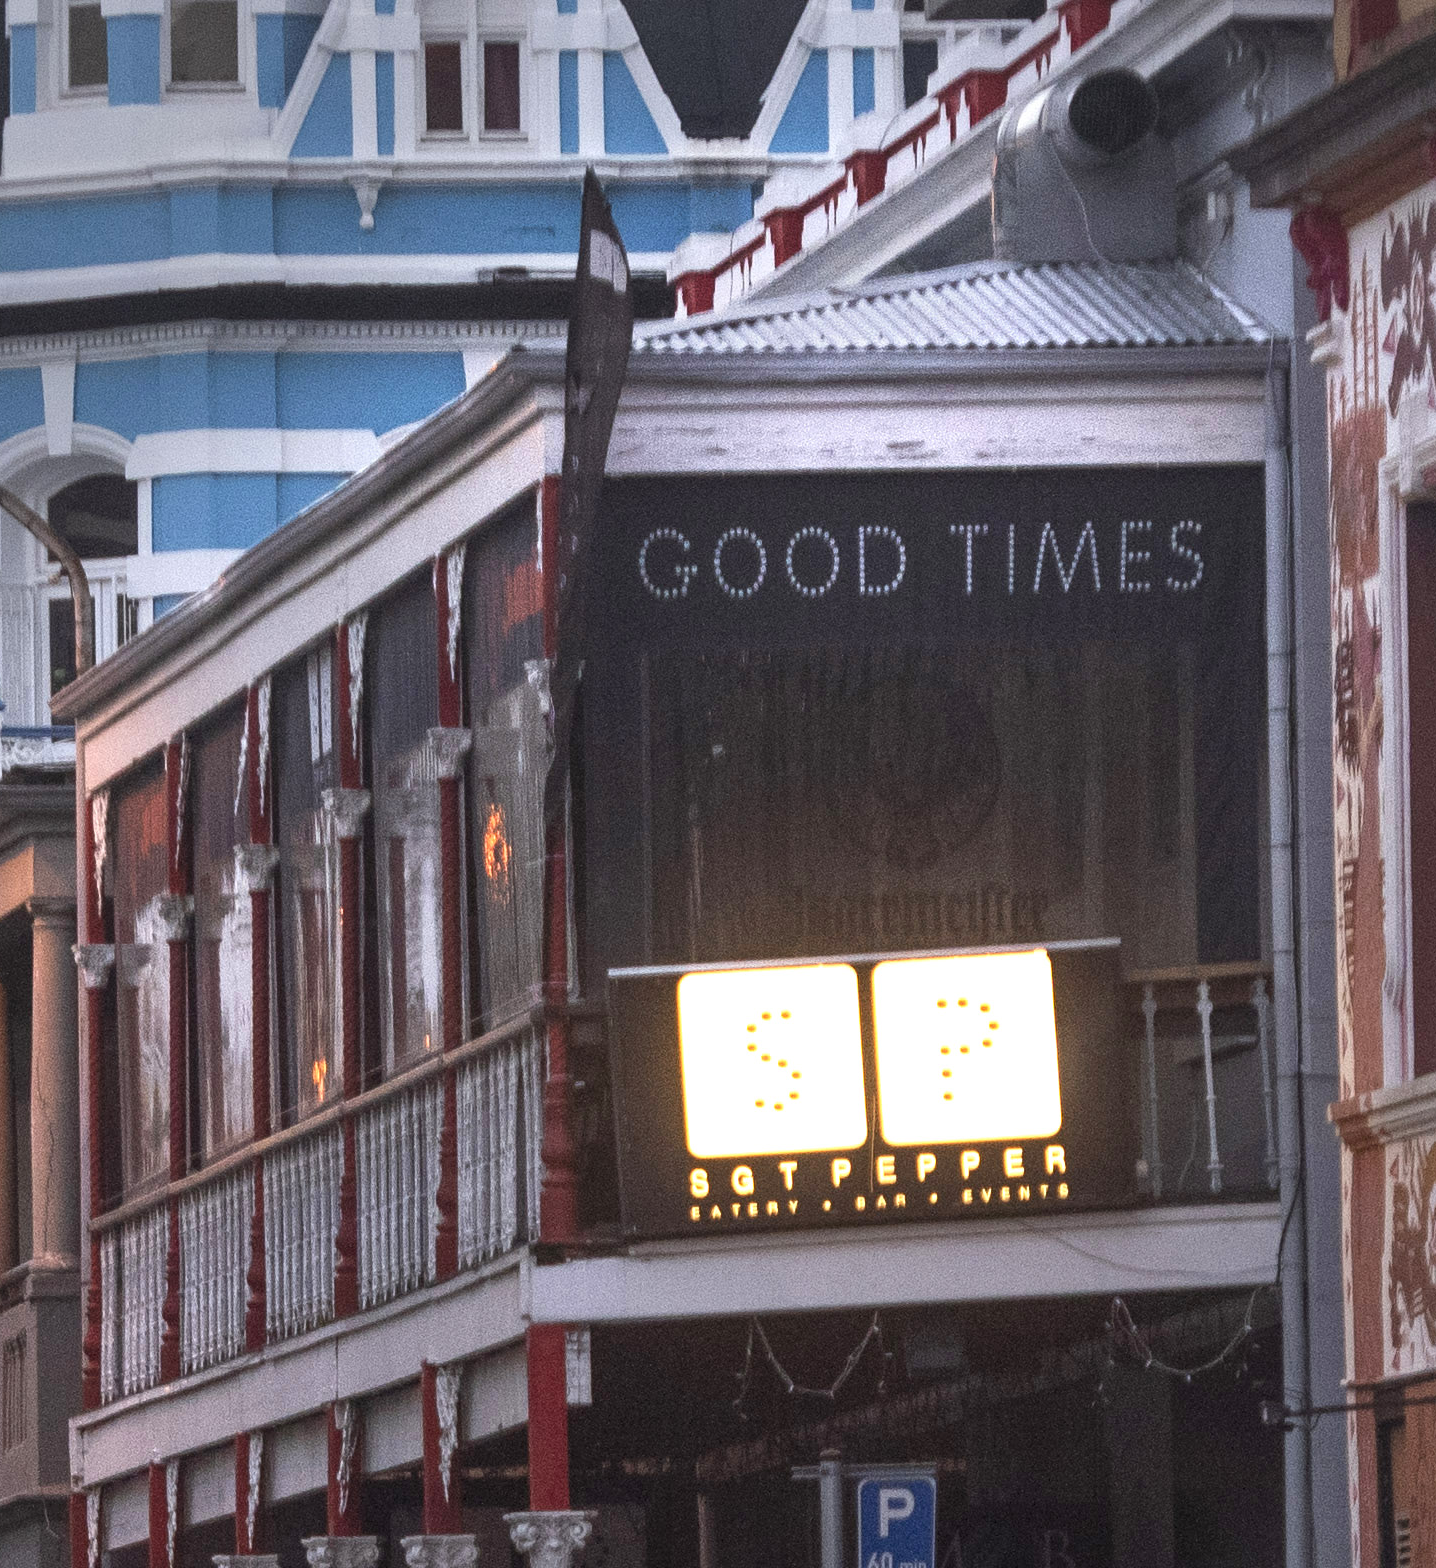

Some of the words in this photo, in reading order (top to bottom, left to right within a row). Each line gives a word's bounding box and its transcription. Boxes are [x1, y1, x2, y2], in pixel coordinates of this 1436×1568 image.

[639, 525, 907, 599] GOOD
[949, 520, 1206, 596] TIMES
[688, 1160, 800, 1200] SGT
[831, 1144, 1069, 1189] PEPPER
[689, 1199, 800, 1222] EATERY
[854, 1193, 908, 1212] BAR
[961, 1182, 1070, 1205] EVENTS
[879, 1487, 917, 1539] P
